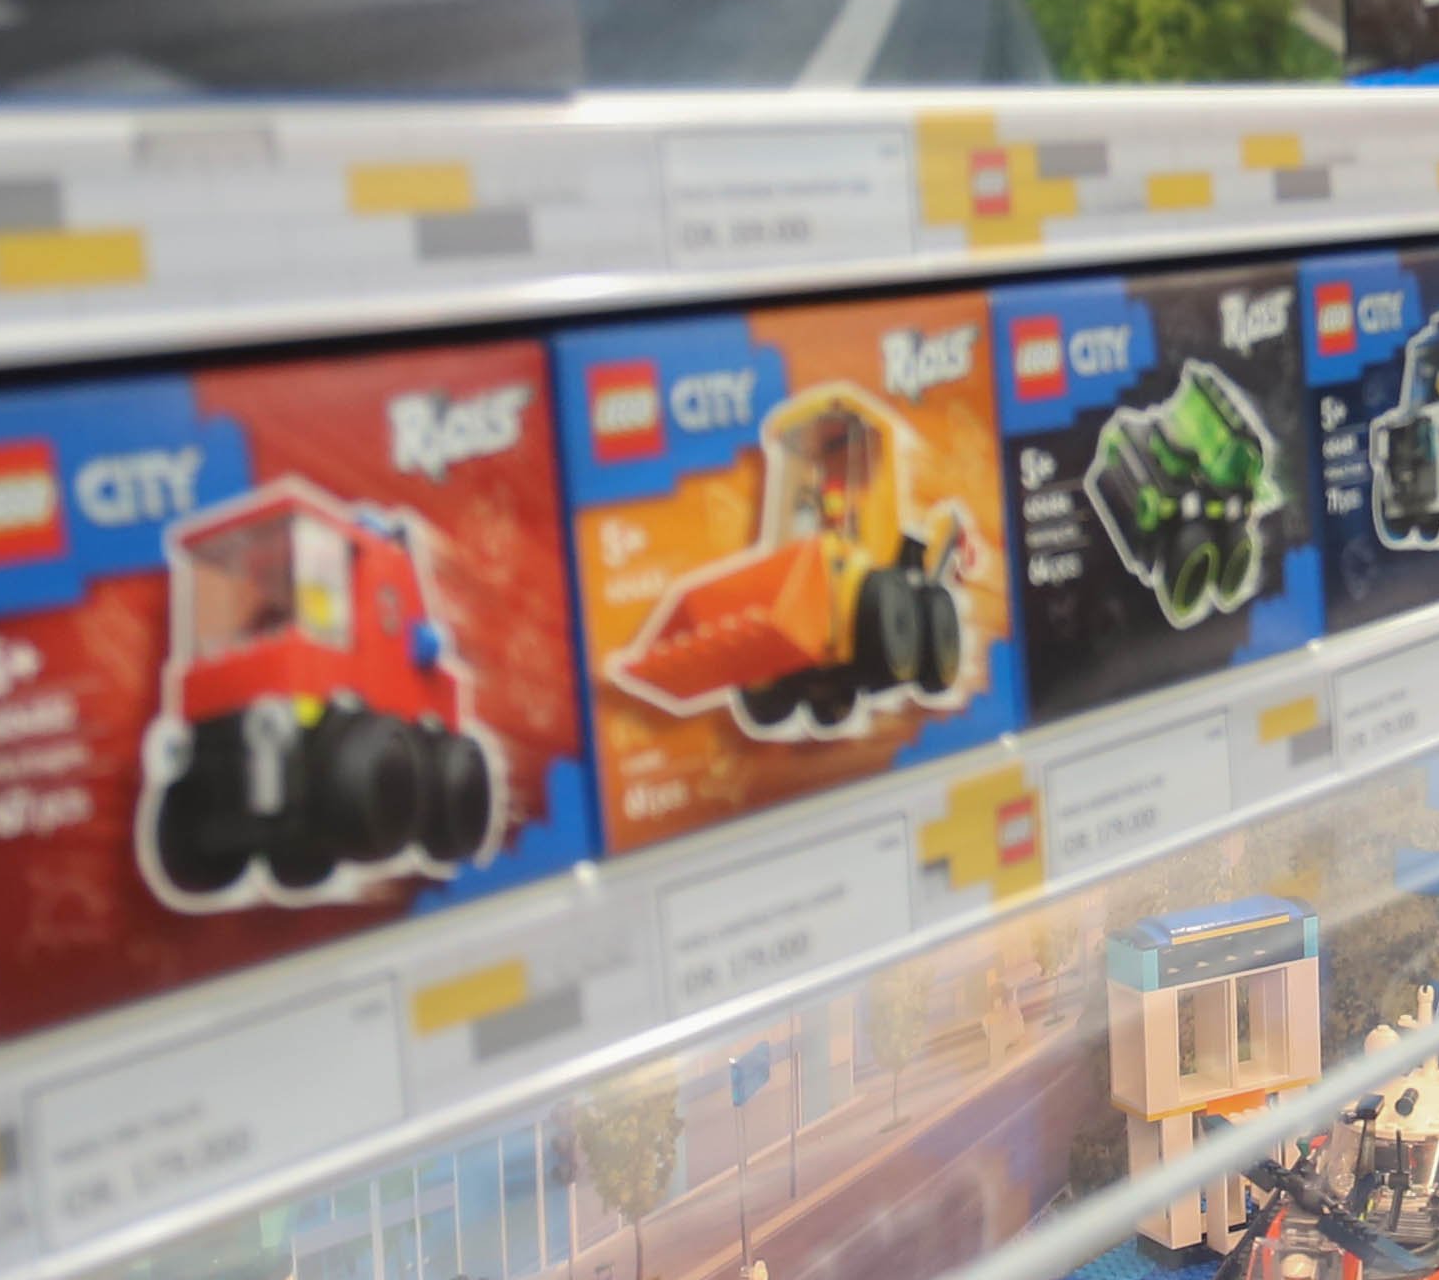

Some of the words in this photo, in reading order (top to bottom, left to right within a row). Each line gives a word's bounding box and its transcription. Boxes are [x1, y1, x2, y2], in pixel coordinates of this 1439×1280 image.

[1317, 303, 1352, 336] LEGO
[1358, 292, 1404, 334] CITY
[1014, 338, 1061, 379] LEGO
[1068, 326, 1132, 378] CITY
[593, 389, 659, 436] LEGO
[671, 368, 757, 432] CITY
[74, 446, 203, 528] CITY
